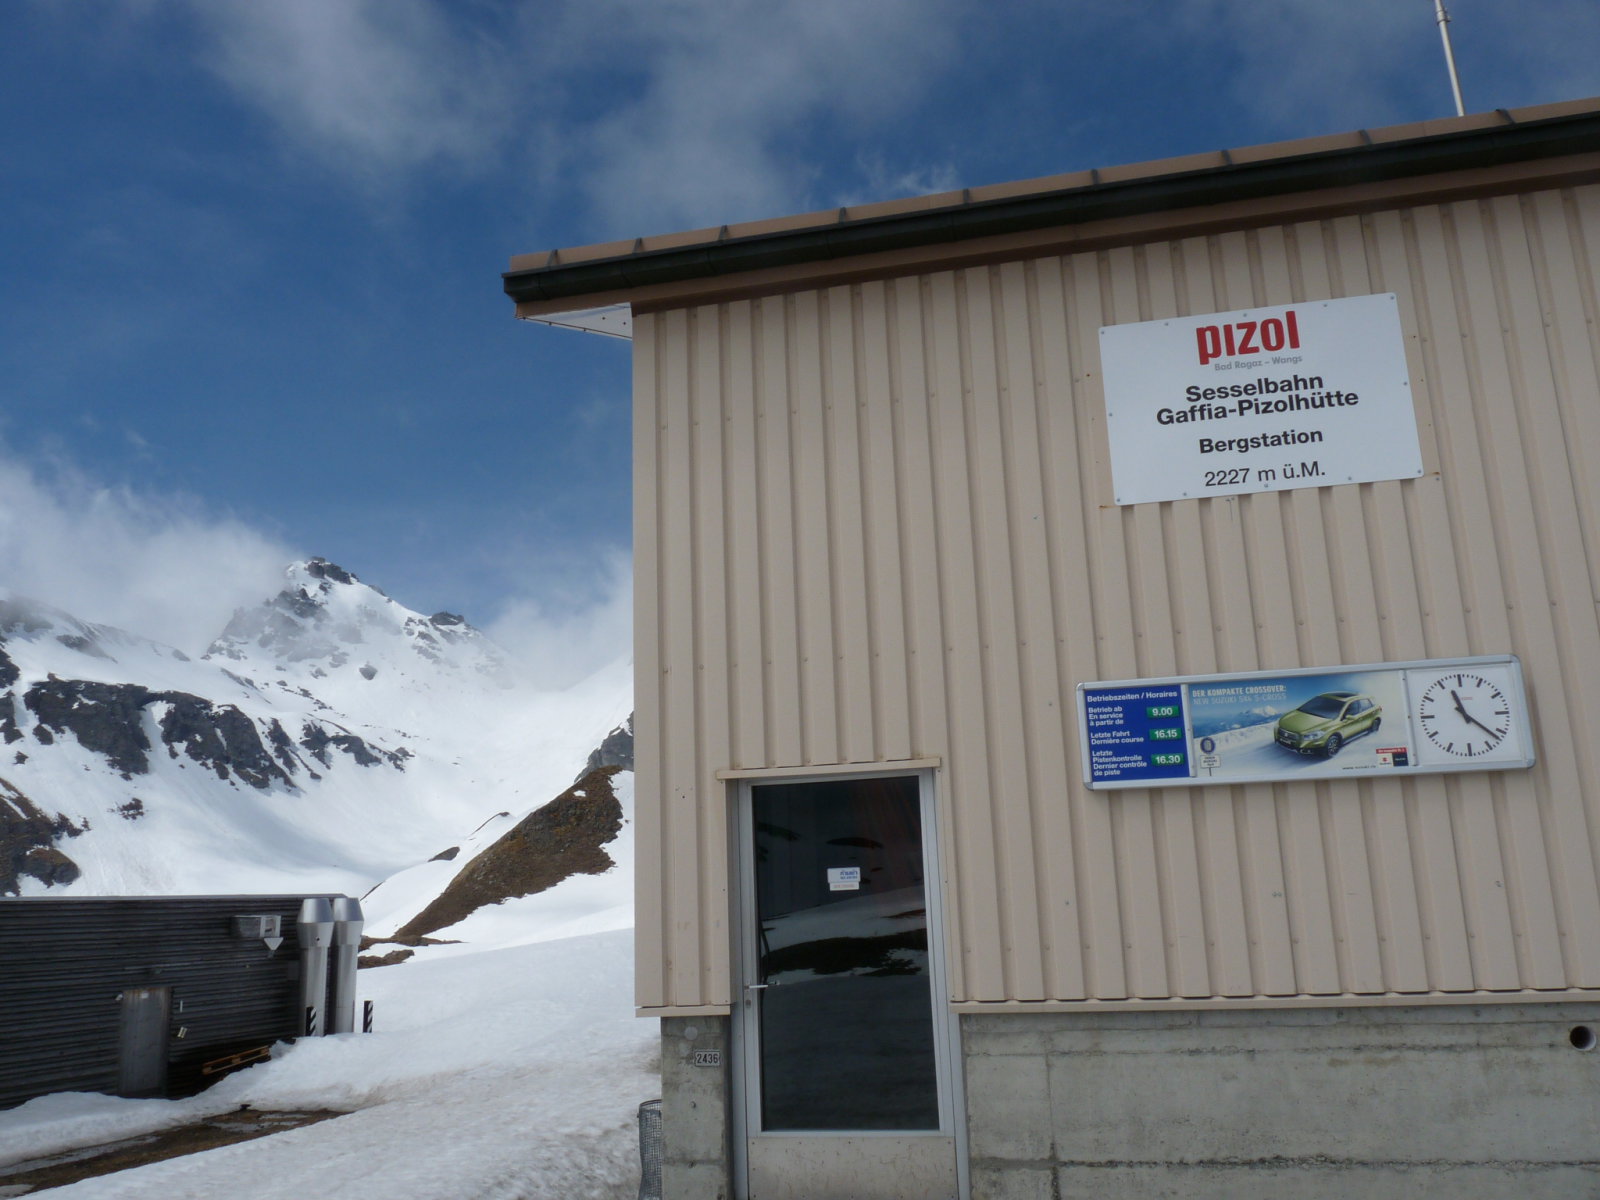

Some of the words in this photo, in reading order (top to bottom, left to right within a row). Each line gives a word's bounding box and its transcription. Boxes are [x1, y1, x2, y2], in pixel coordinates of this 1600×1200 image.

[1214, 362, 1232, 371] Bad
[1235, 360, 1263, 370] Ragaz
[1272, 355, 1303, 366] Wangs
[1186, 374, 1324, 403] Sesselbahn
[1156, 390, 1359, 425] Gaffia-Pizolhütte
[1199, 429, 1323, 454] Bergstation
[1205, 467, 1251, 487] 2227
[1257, 467, 1276, 482] m
[1283, 460, 1326, 479] ü.M.
[1087, 693, 1139, 702] Betriebszeiten
[1146, 691, 1178, 699] Horaires
[1207, 688, 1243, 697] KOMPAKTE
[1088, 706, 1113, 714] Betrieb
[1152, 707, 1173, 716] 9.00
[1095, 719, 1114, 727] partir
[1154, 729, 1178, 739] 16.15
[1092, 755, 1142, 763] Pistenkontrolle
[1155, 755, 1181, 764] 16.30
[1093, 762, 1118, 770] Dernier
[1119, 761, 1147, 769] contrôle
[696, 1053, 719, 1064] 2436
